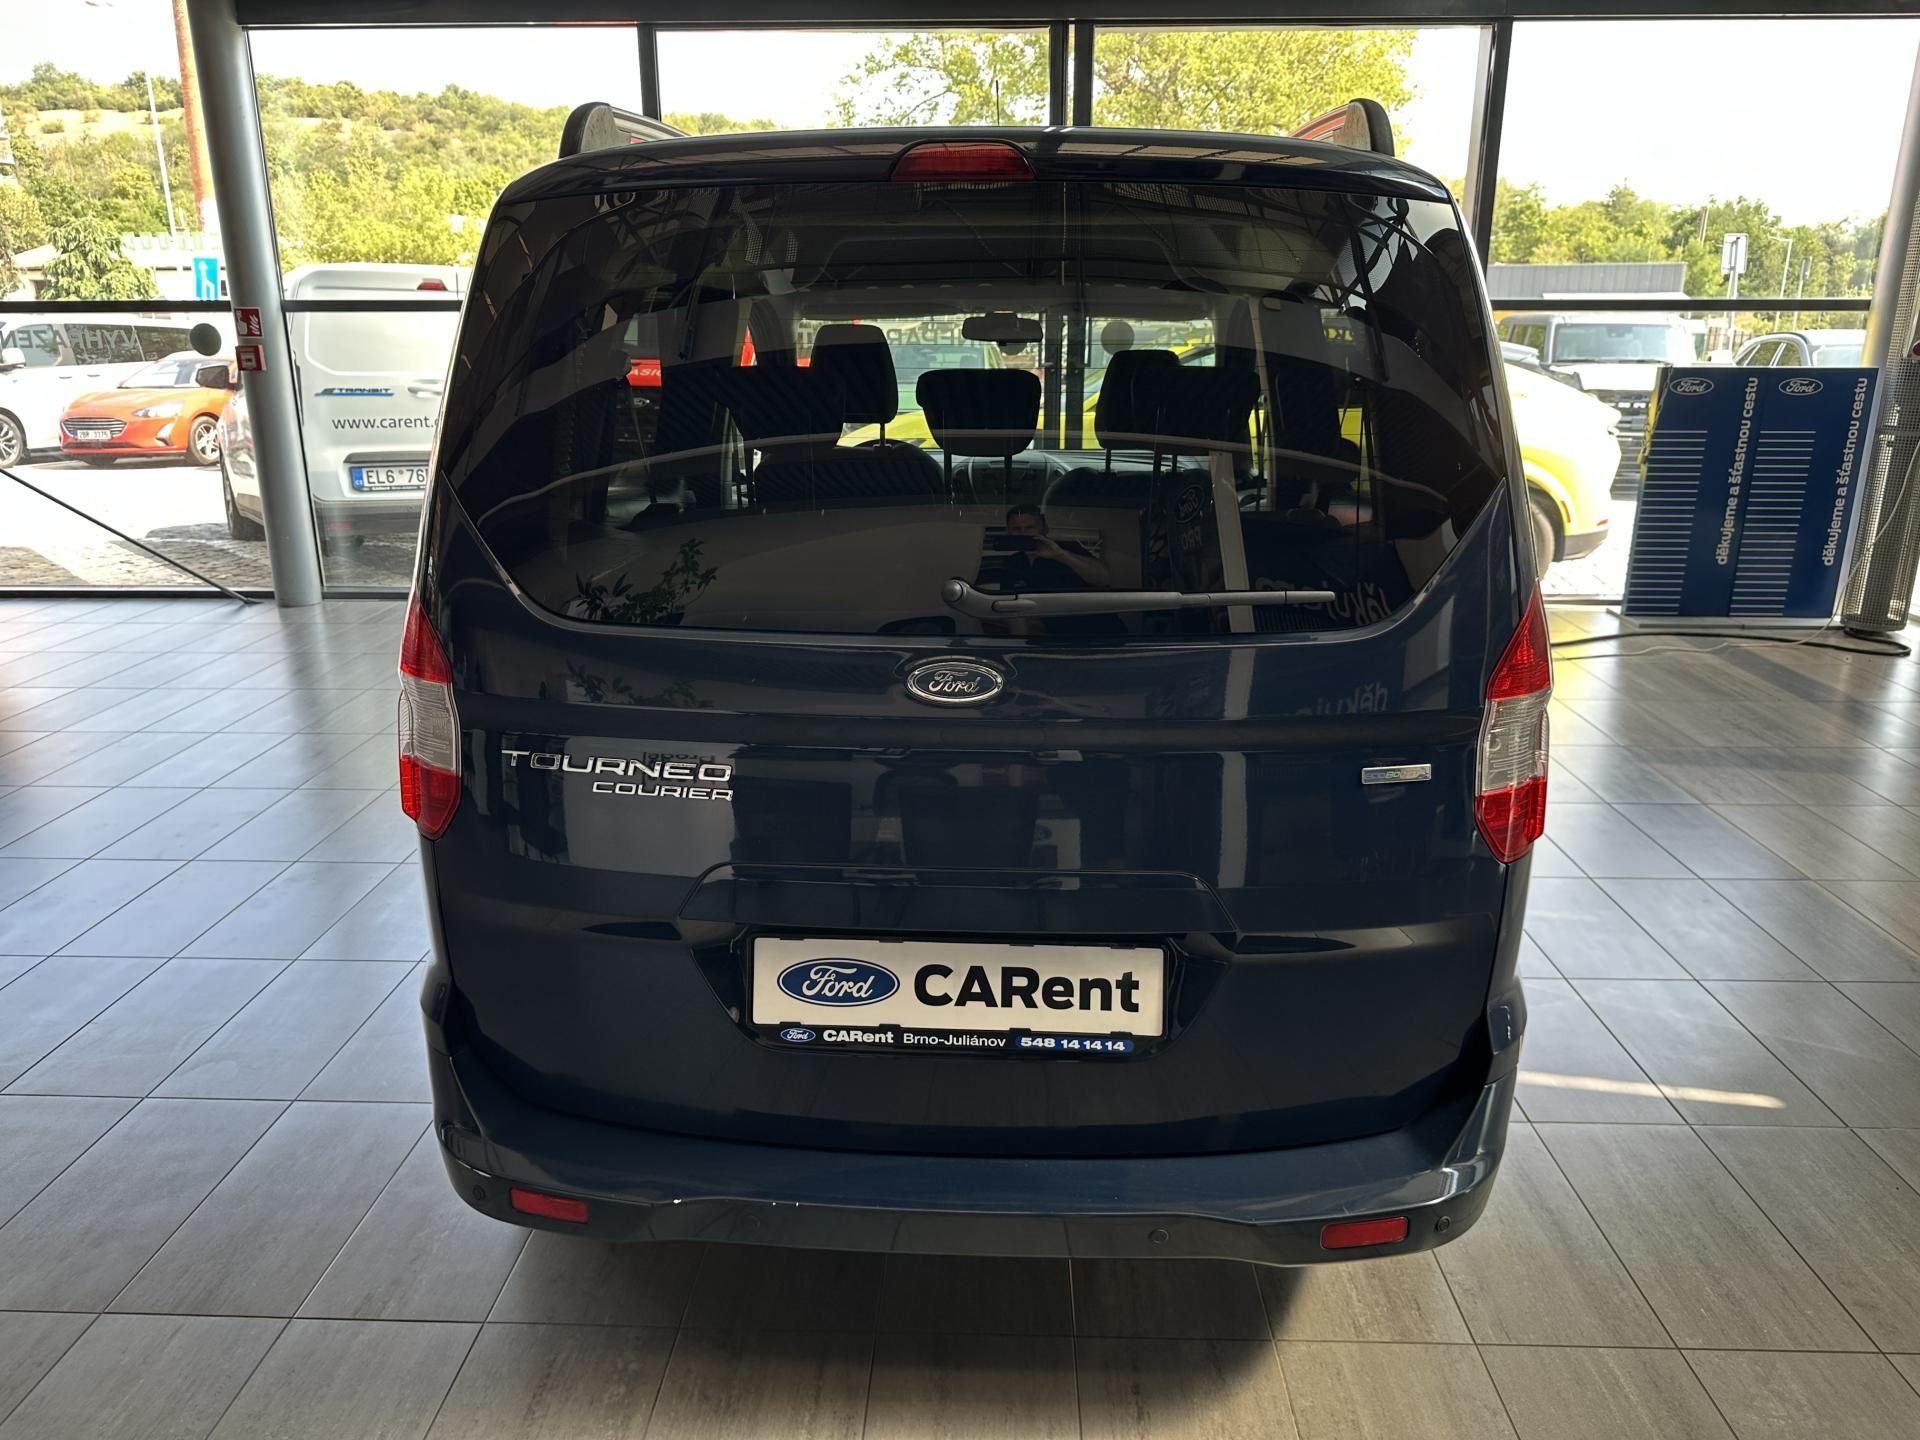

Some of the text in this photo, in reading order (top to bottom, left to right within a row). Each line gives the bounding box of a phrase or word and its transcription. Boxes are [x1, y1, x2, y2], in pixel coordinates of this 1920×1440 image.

[366, 468, 429, 484] EL6 76
[1715, 495, 1738, 565] děkujeme
[1743, 376, 1759, 418] cestu
[1822, 496, 1845, 566] děkujeme
[1852, 377, 1868, 418] cestu
[928, 670, 981, 693] Ford
[501, 749, 733, 782] TOURNEO
[592, 781, 734, 801] COURIER
[801, 963, 1140, 1012] Ford CARent
[822, 1029, 894, 1043] CARent
[903, 1032, 1006, 1047] Brno-Juliánov
[1020, 1037, 1055, 1048] 548
[1061, 1039, 1080, 1049] 14
[1083, 1040, 1102, 1050] 14
[1105, 1041, 1126, 1051] 14
